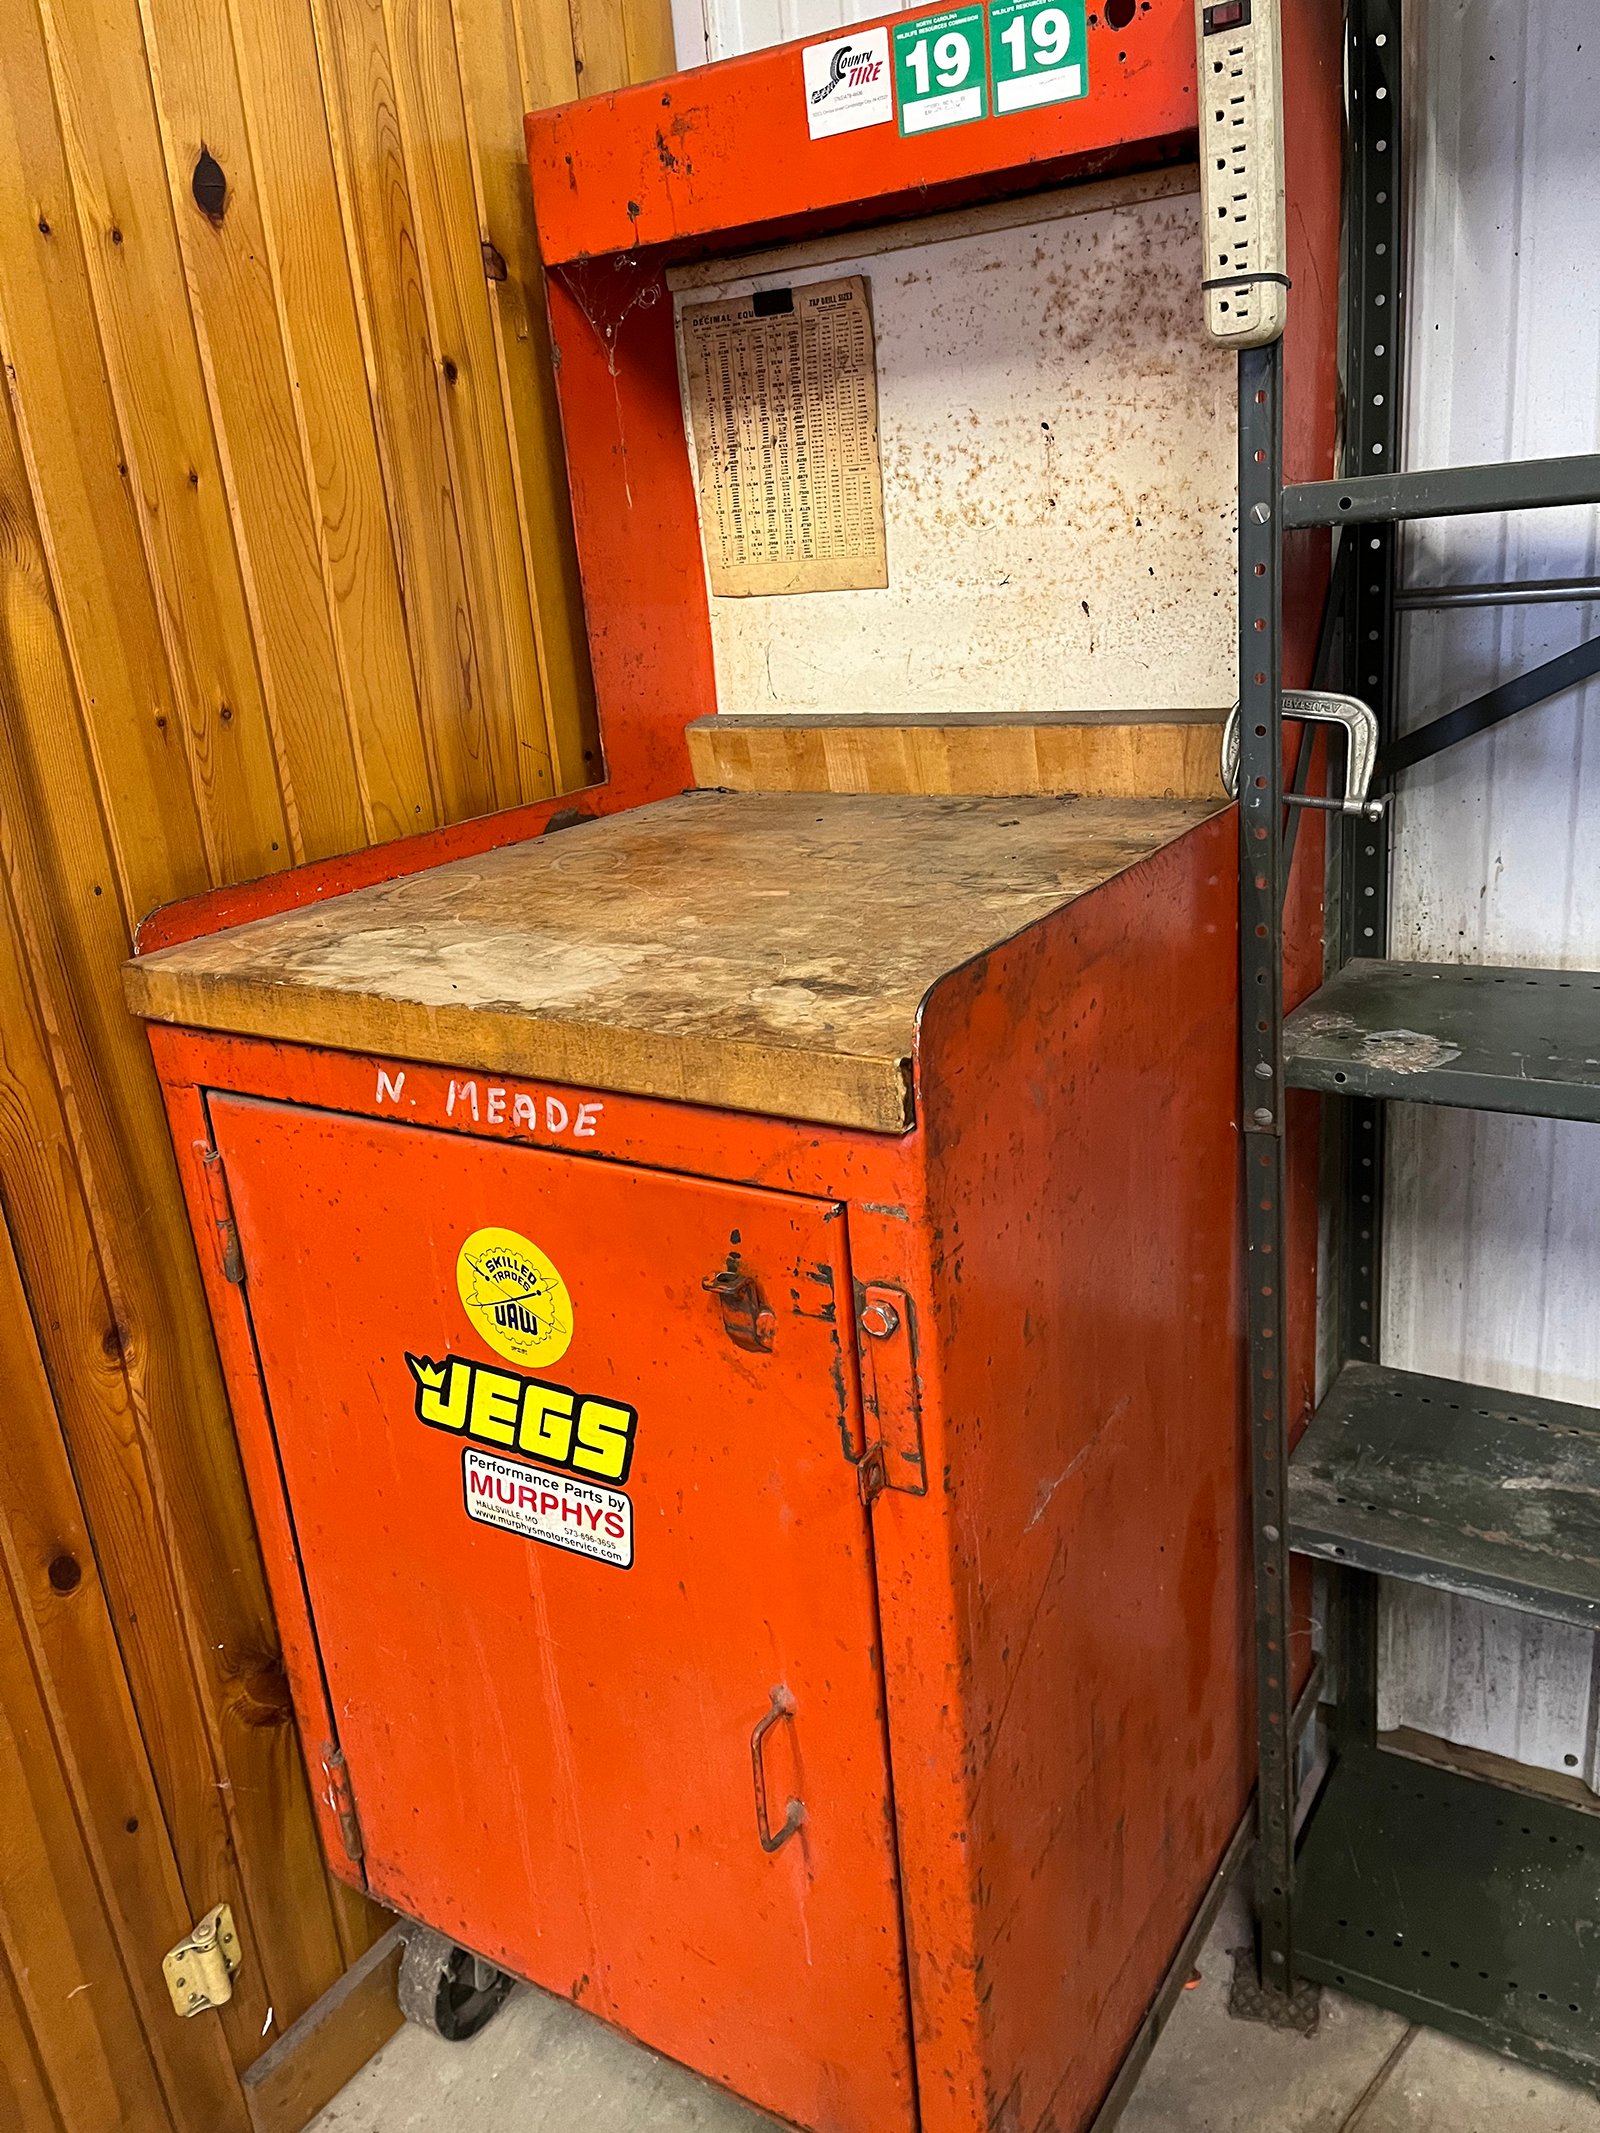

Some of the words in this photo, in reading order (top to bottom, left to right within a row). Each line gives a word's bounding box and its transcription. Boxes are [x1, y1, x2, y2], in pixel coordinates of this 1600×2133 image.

[916, 19, 932, 28] NORTH
[933, 13, 957, 24] CAROLINA
[1001, 8, 1071, 72] 19
[848, 61, 883, 88] TIRE
[905, 32, 970, 94] 19
[692, 314, 732, 327] DECIMAL
[737, 310, 755, 320] EQU
[374, 1068, 417, 1106] N.
[445, 1079, 604, 1138] MEADE
[485, 1256, 537, 1286] SKILLED
[492, 1270, 531, 1292] TRADES
[494, 1303, 538, 1336] UAW
[421, 1361, 631, 1478] JEGS
[469, 1454, 560, 1491] Performance
[564, 1483, 603, 1504] Parts
[608, 1495, 625, 1513] by
[470, 1470, 625, 1539] MURPHYS
[474, 1509, 623, 1562] www.murphysmotorservice.com
[525, 1514, 538, 1525] MO
